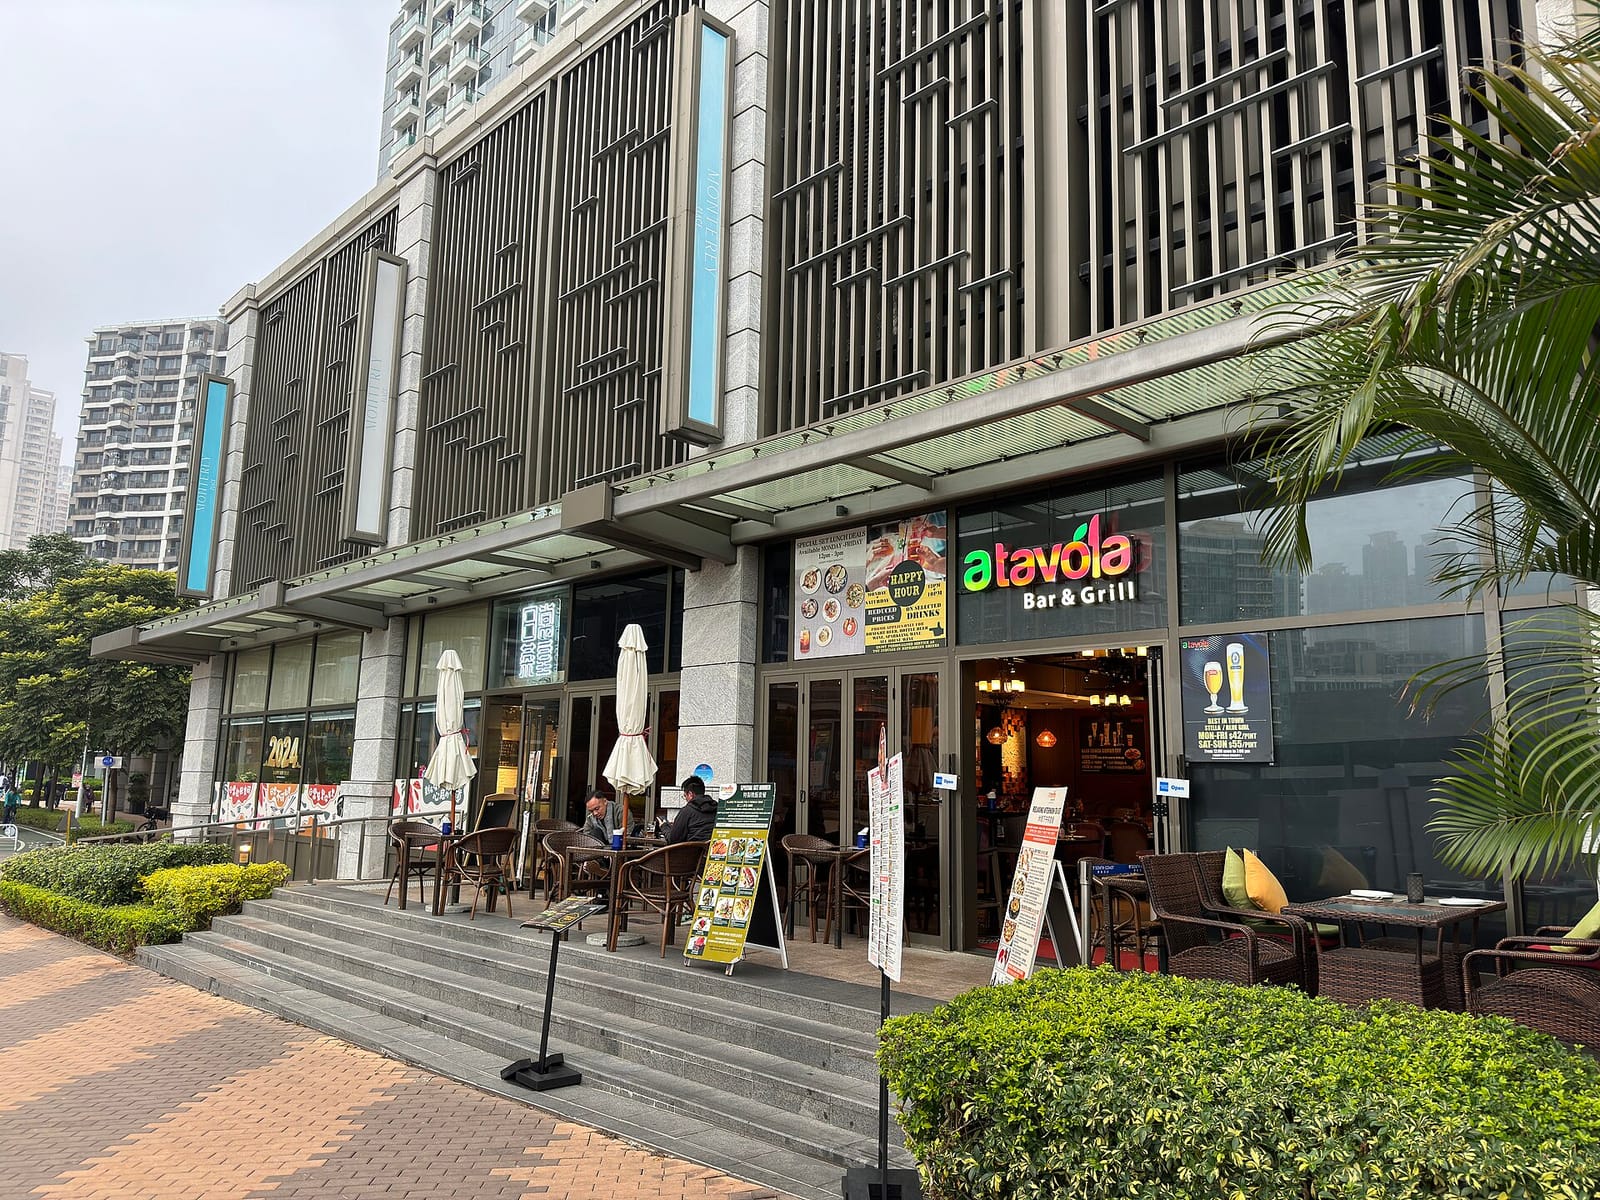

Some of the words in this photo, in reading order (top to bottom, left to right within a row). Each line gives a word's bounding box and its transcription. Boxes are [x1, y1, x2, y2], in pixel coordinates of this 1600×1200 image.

[704, 168, 720, 275] MONTEREY
[797, 540, 817, 549] SPECIAL
[849, 530, 866, 539] DEALS
[890, 570, 923, 585] HAPPY
[894, 586, 920, 598] HOUR
[1023, 592, 1056, 609] Bar
[1061, 588, 1076, 606] &
[1080, 581, 1135, 604] Grill
[867, 607, 897, 615] REDUCED
[907, 609, 940, 620] DRINKS
[872, 615, 895, 623] PRICES
[1198, 731, 1228, 740] MON-FRI
[1198, 740, 1228, 748] SAT-SUN
[267, 735, 300, 769] 2024
